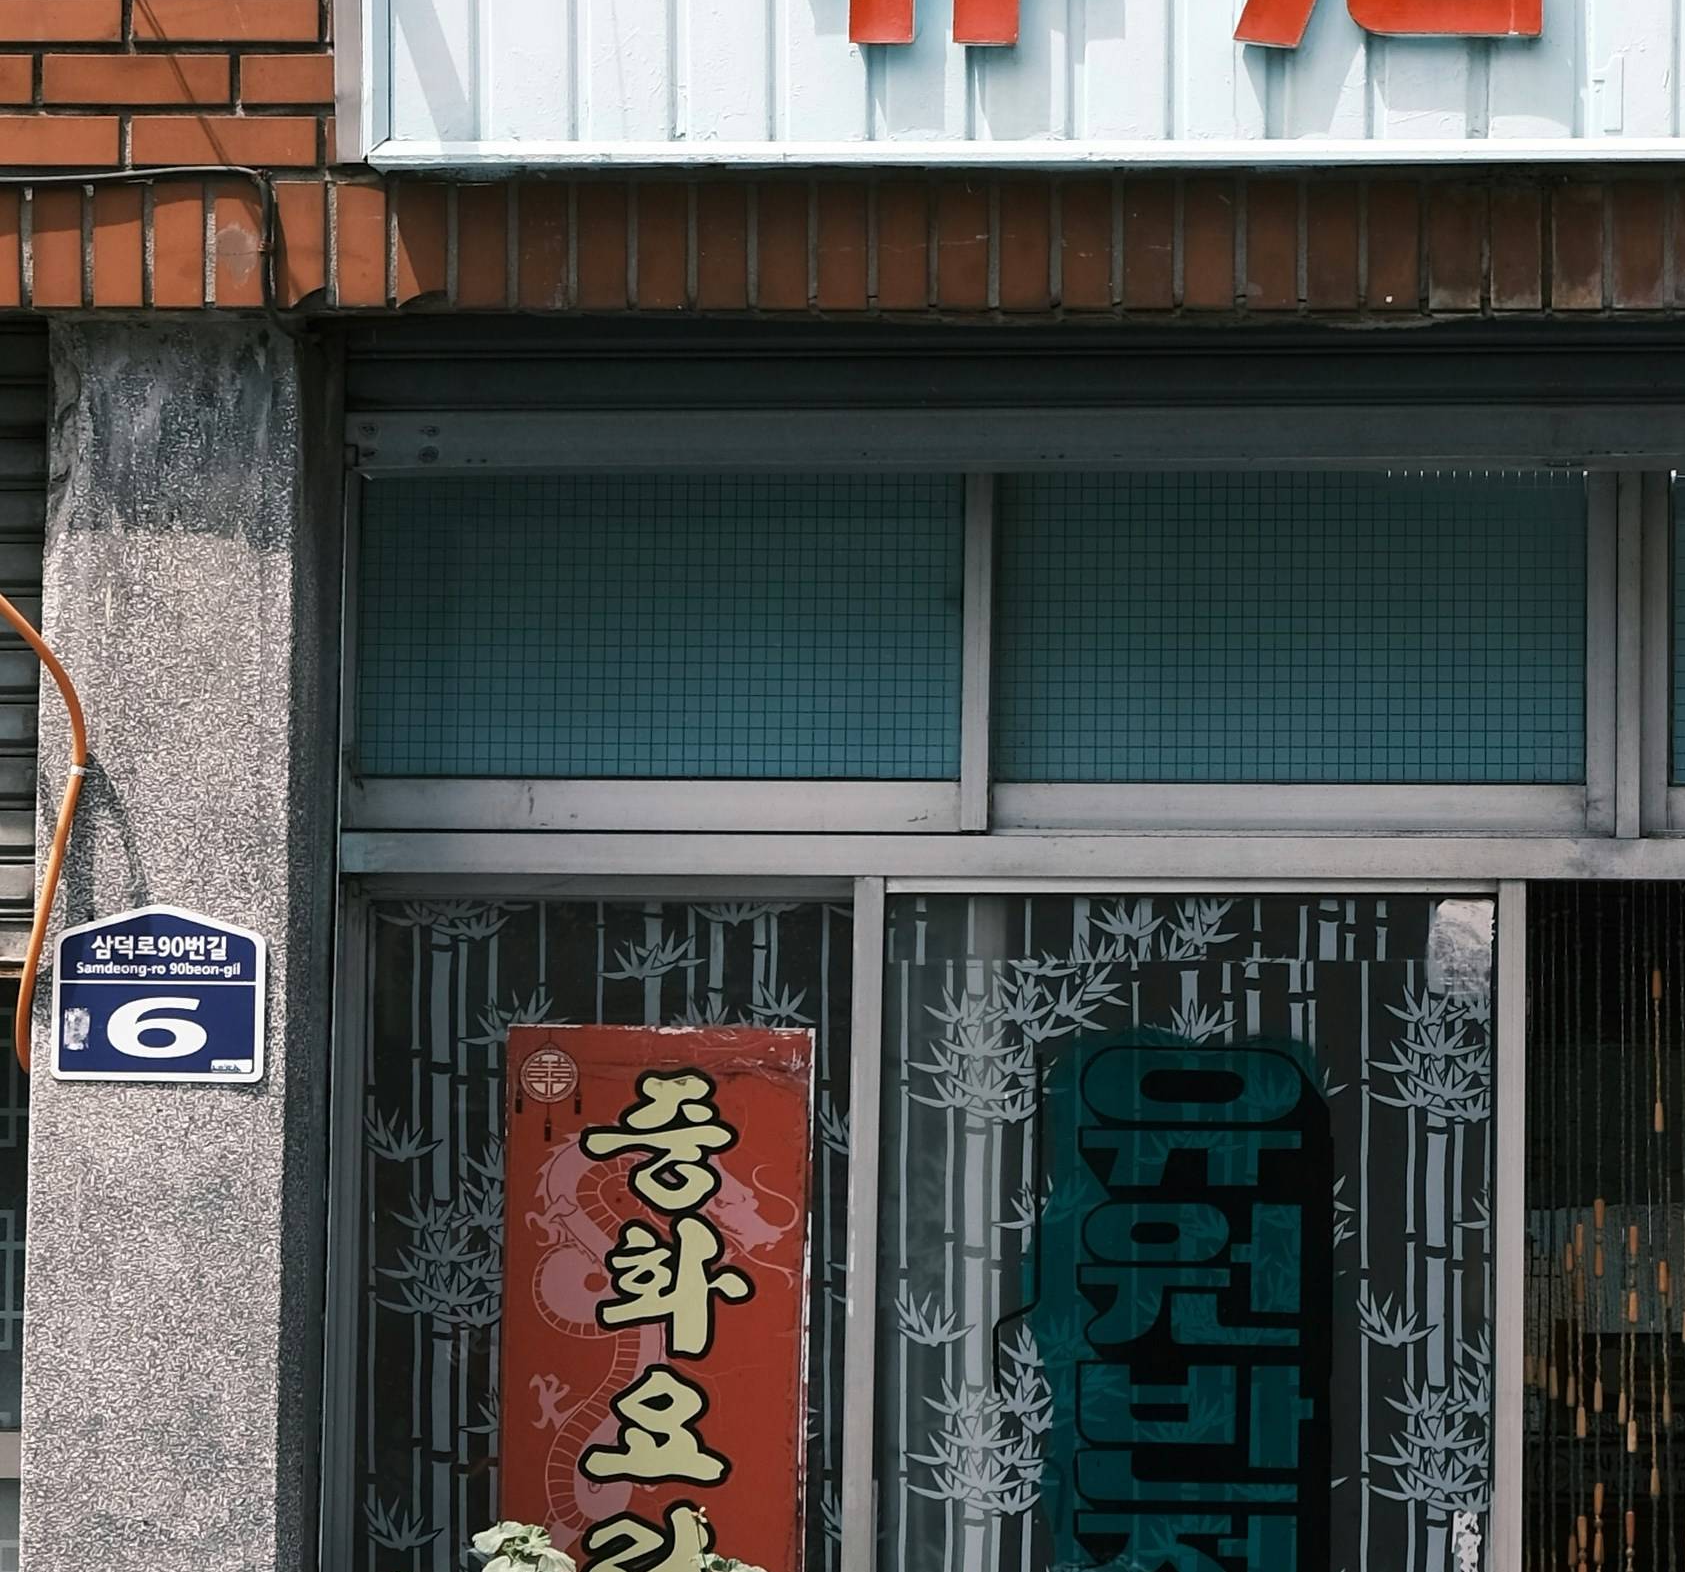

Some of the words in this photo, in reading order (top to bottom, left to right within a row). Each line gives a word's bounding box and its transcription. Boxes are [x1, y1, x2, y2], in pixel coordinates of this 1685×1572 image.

[91, 935, 228, 960] 삼덕로90번길
[170, 962, 241, 977] 90beon-gil
[107, 997, 207, 1058] 6
